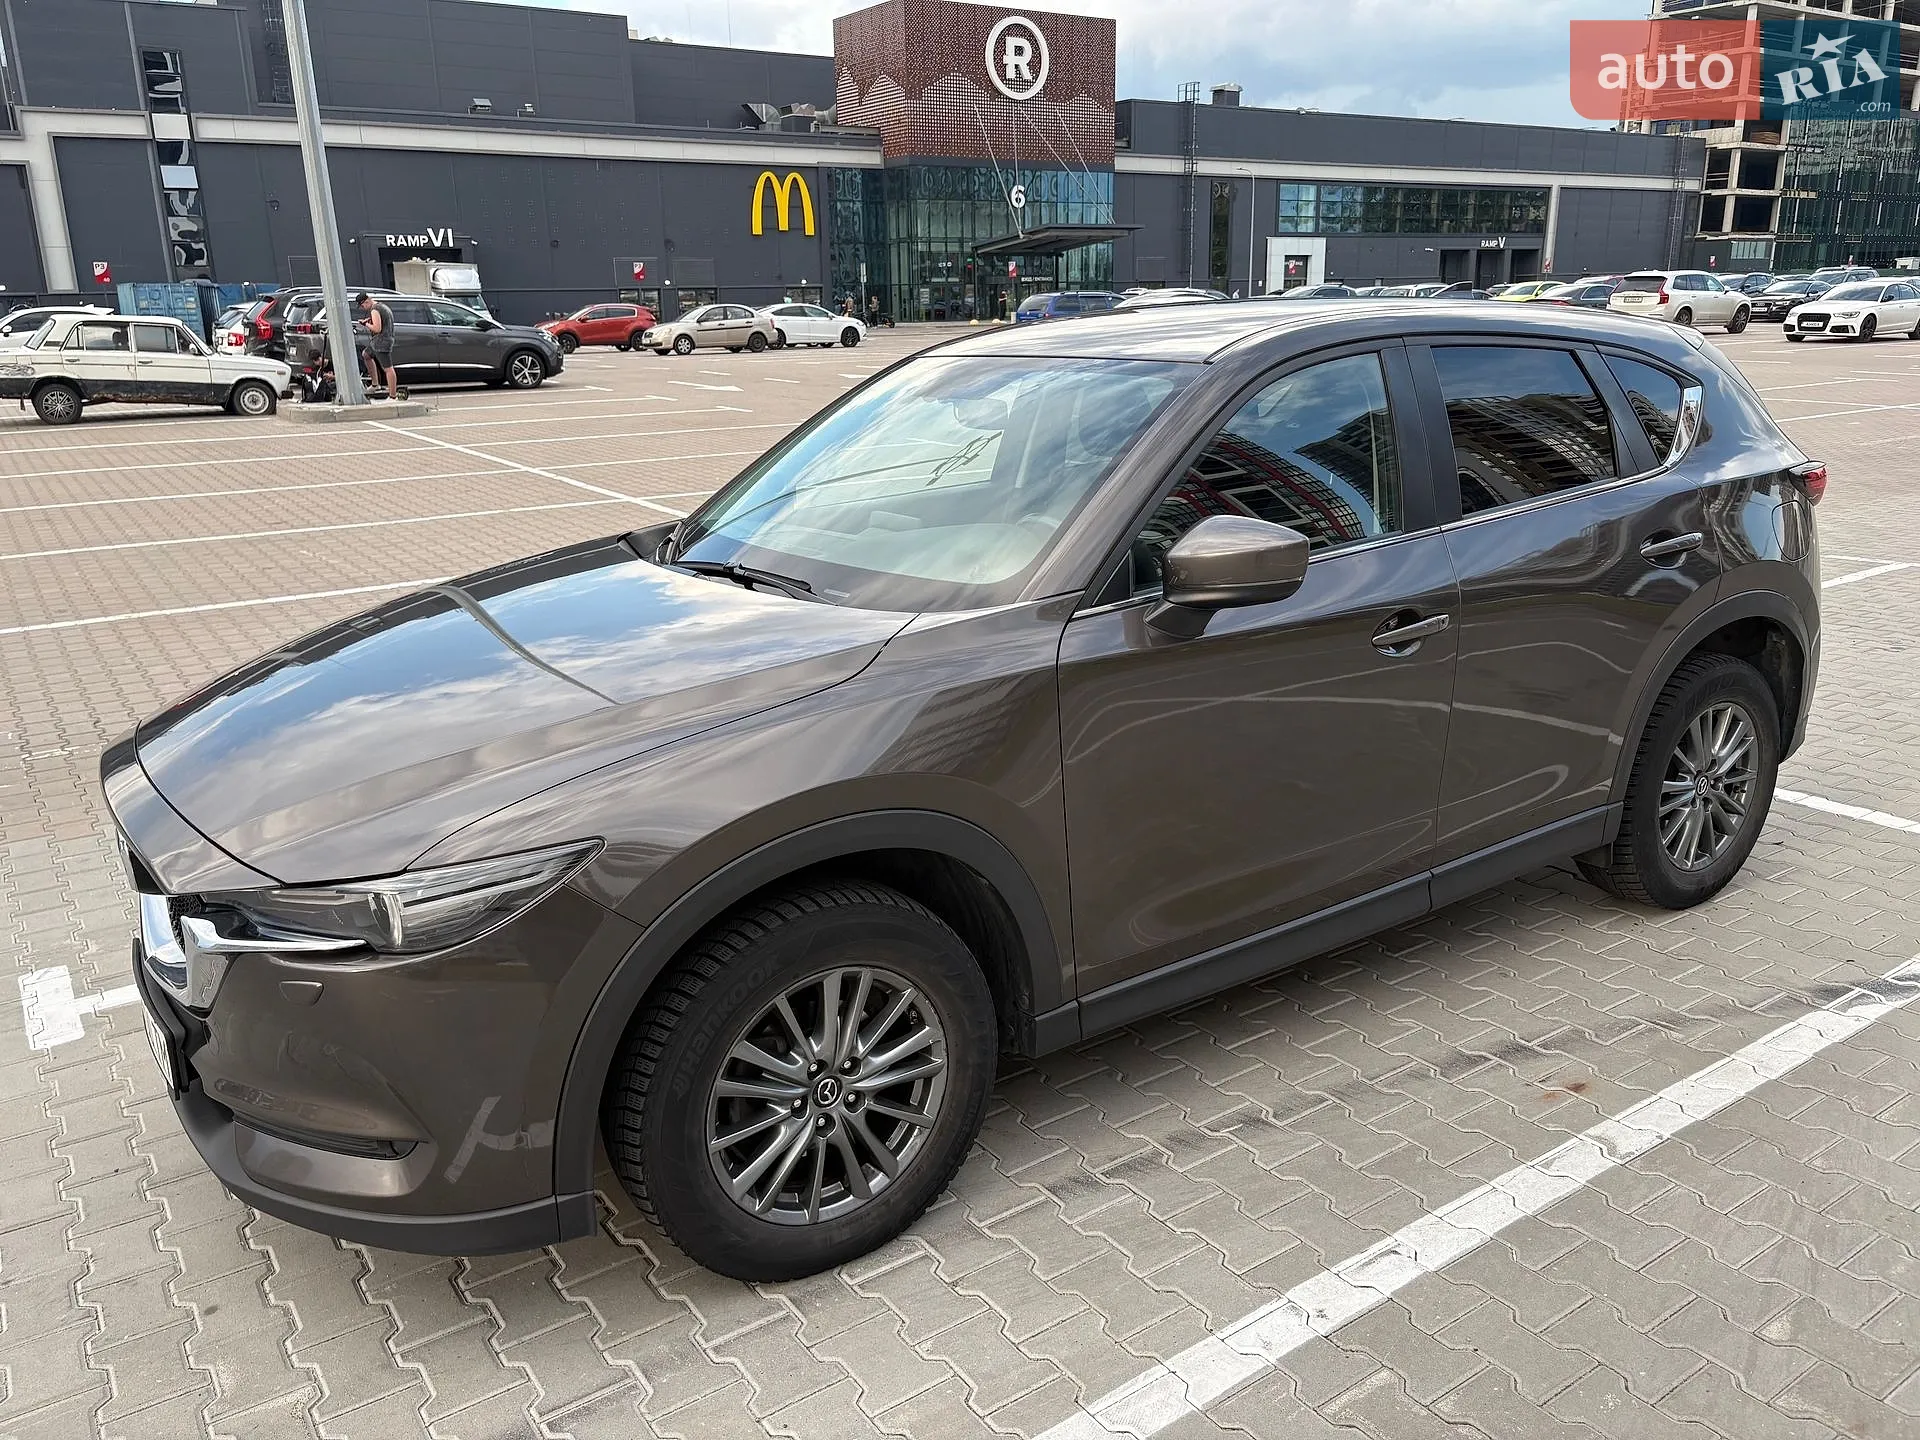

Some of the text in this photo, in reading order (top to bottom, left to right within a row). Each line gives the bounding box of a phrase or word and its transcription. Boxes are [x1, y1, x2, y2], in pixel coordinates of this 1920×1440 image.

[1010, 184, 1026, 209] 6
[385, 227, 454, 248] RAMP VI
[1480, 236, 1506, 249] RAMP V
